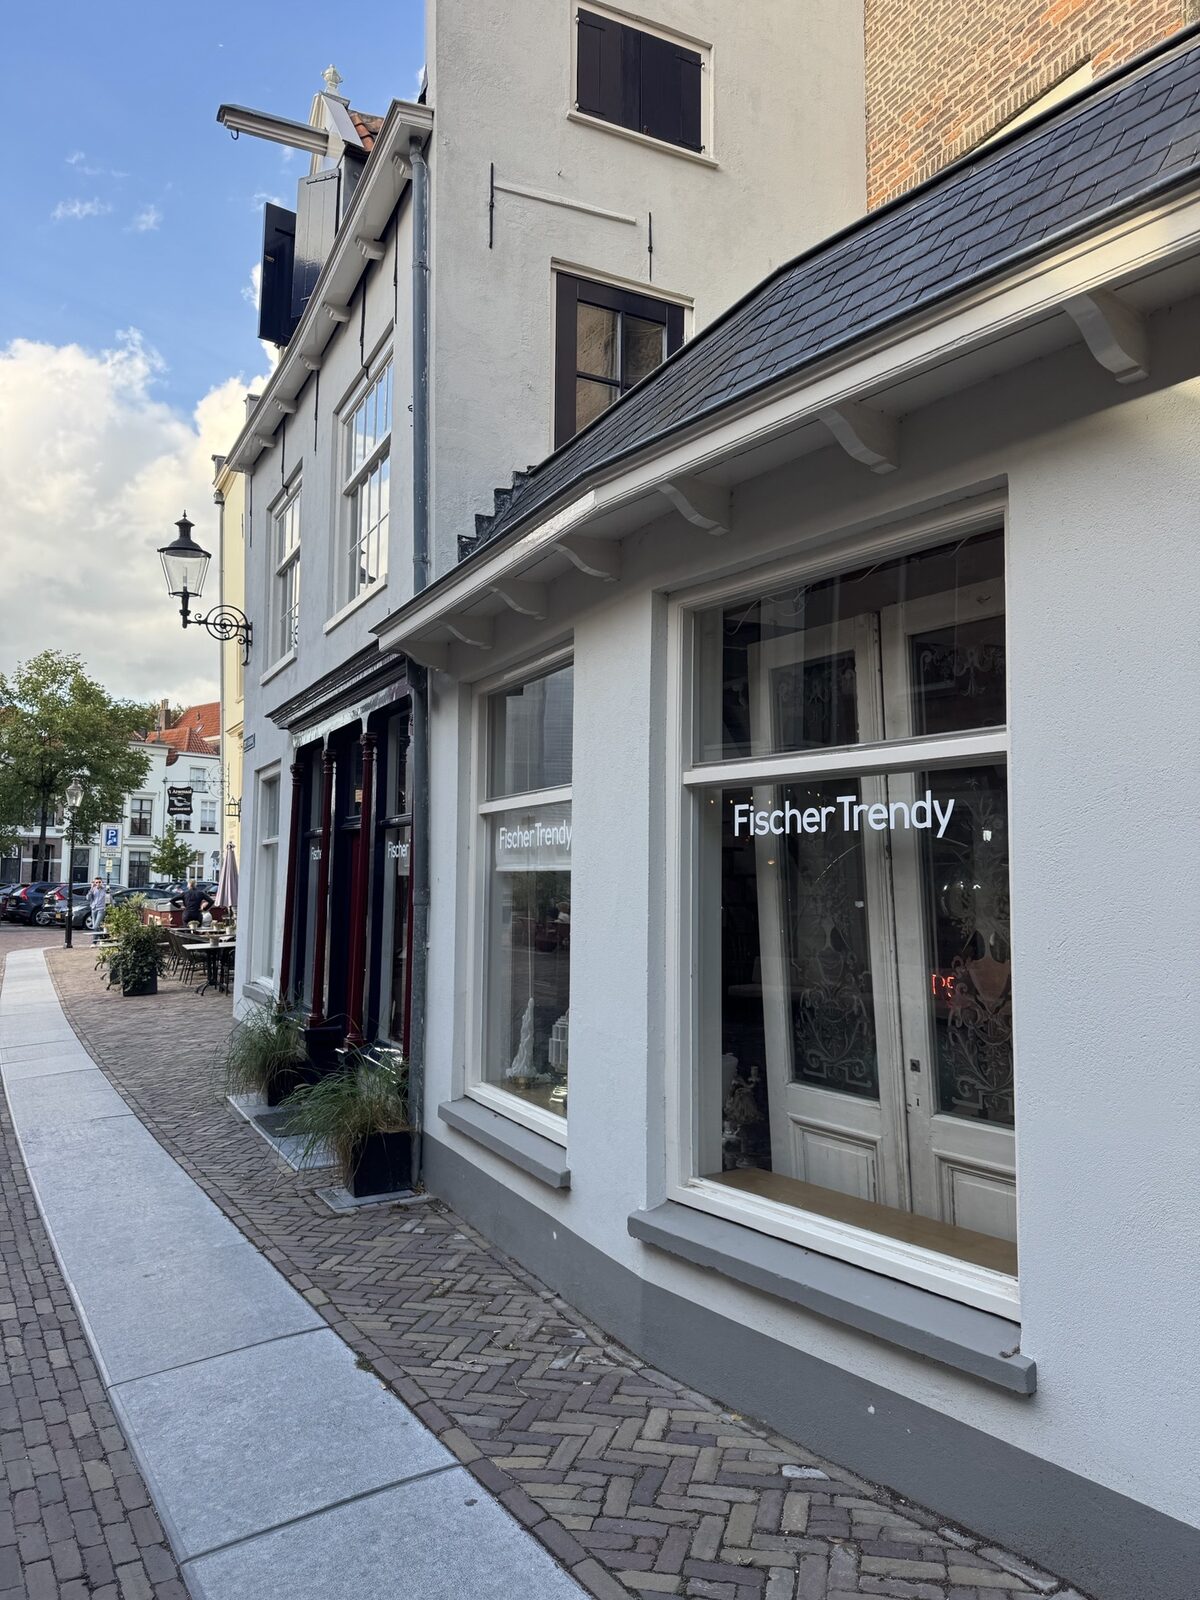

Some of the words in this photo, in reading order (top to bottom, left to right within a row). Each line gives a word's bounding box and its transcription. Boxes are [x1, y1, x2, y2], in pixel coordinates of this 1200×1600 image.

[734, 790, 955, 838] FischerTrendy
[387, 839, 411, 859] Fischer
[499, 819, 572, 851] FischerTrendy
